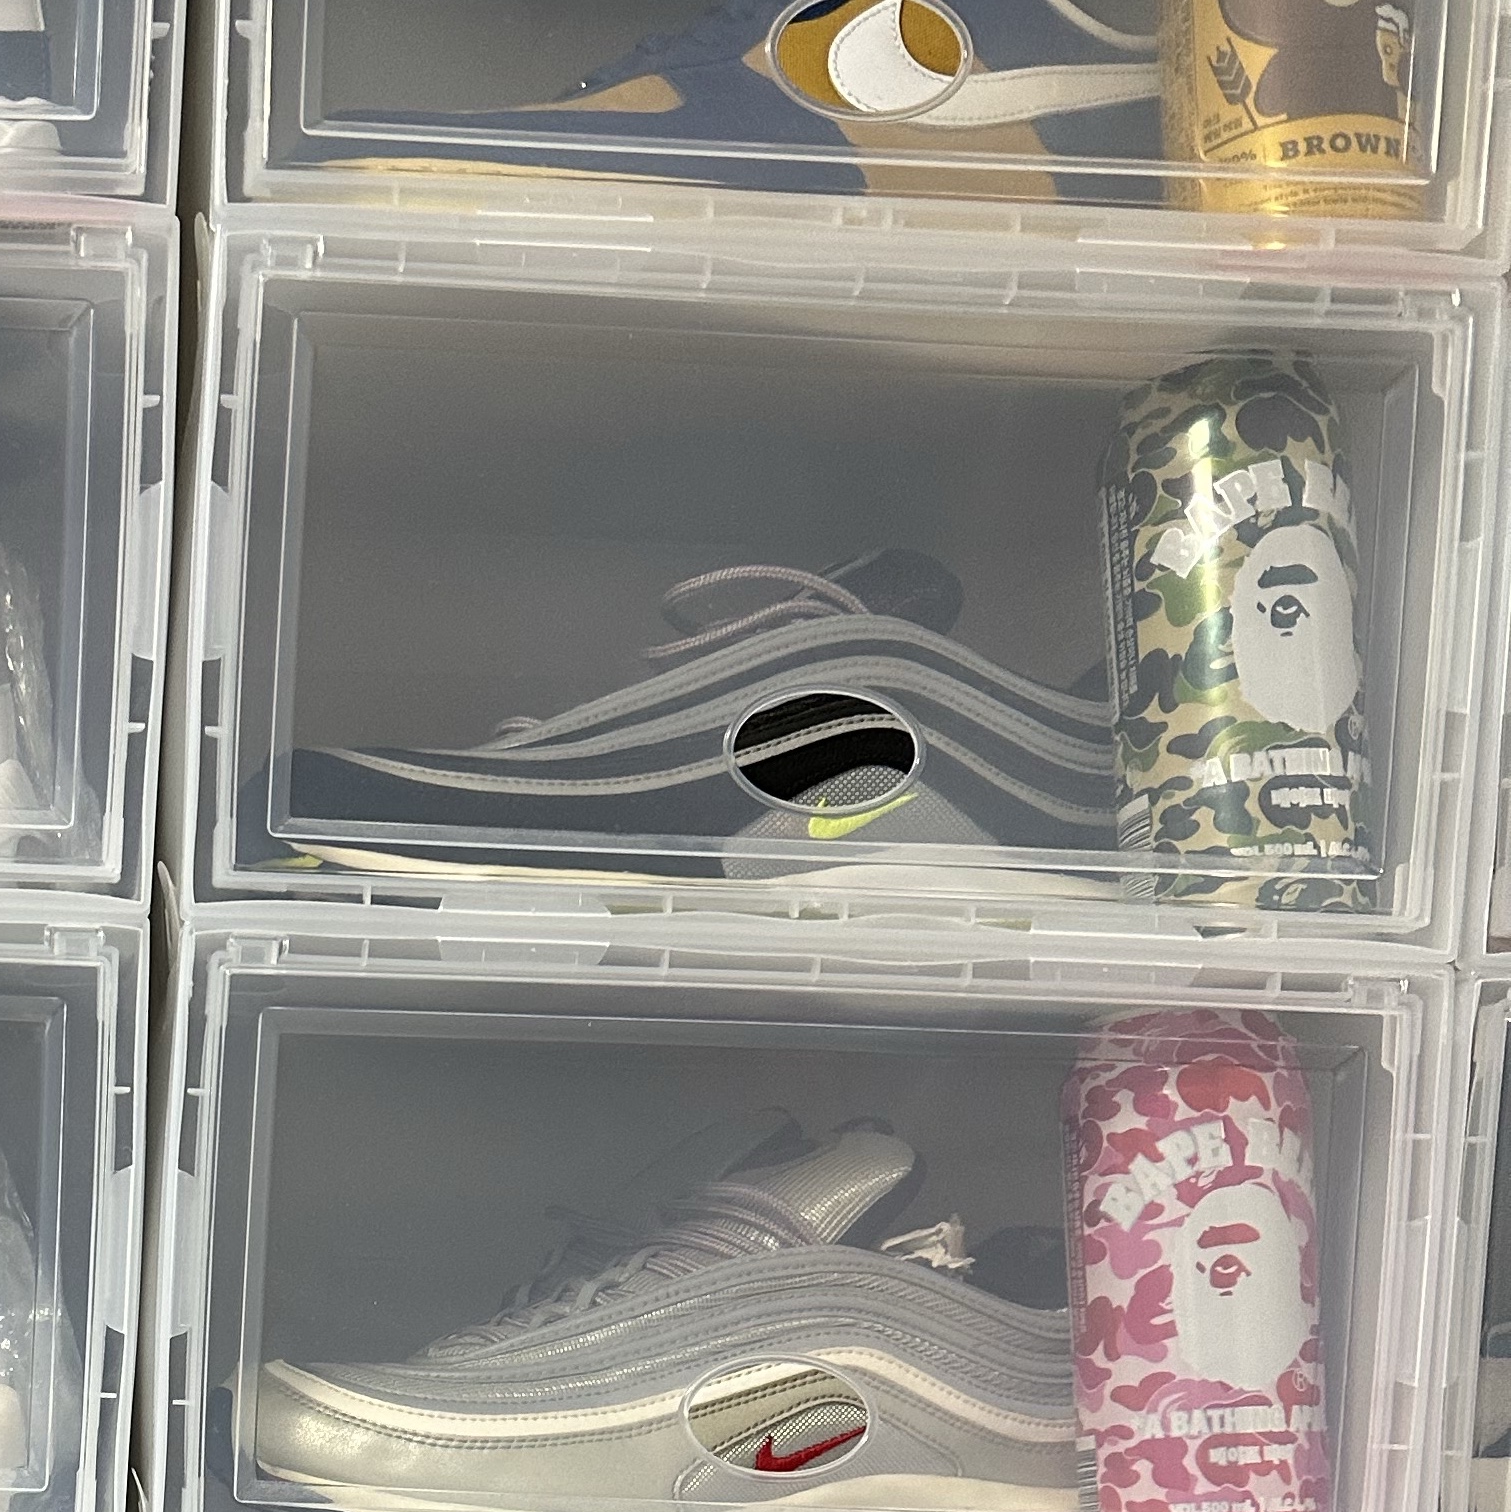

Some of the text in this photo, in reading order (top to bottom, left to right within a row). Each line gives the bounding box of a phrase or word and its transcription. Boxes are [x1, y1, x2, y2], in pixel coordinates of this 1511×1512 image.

[1279, 131, 1403, 162] BROWN
[1149, 458, 1292, 580] BAPE
[1099, 1119, 1234, 1233] BAPE
[1169, 1404, 1288, 1440] BATHING
